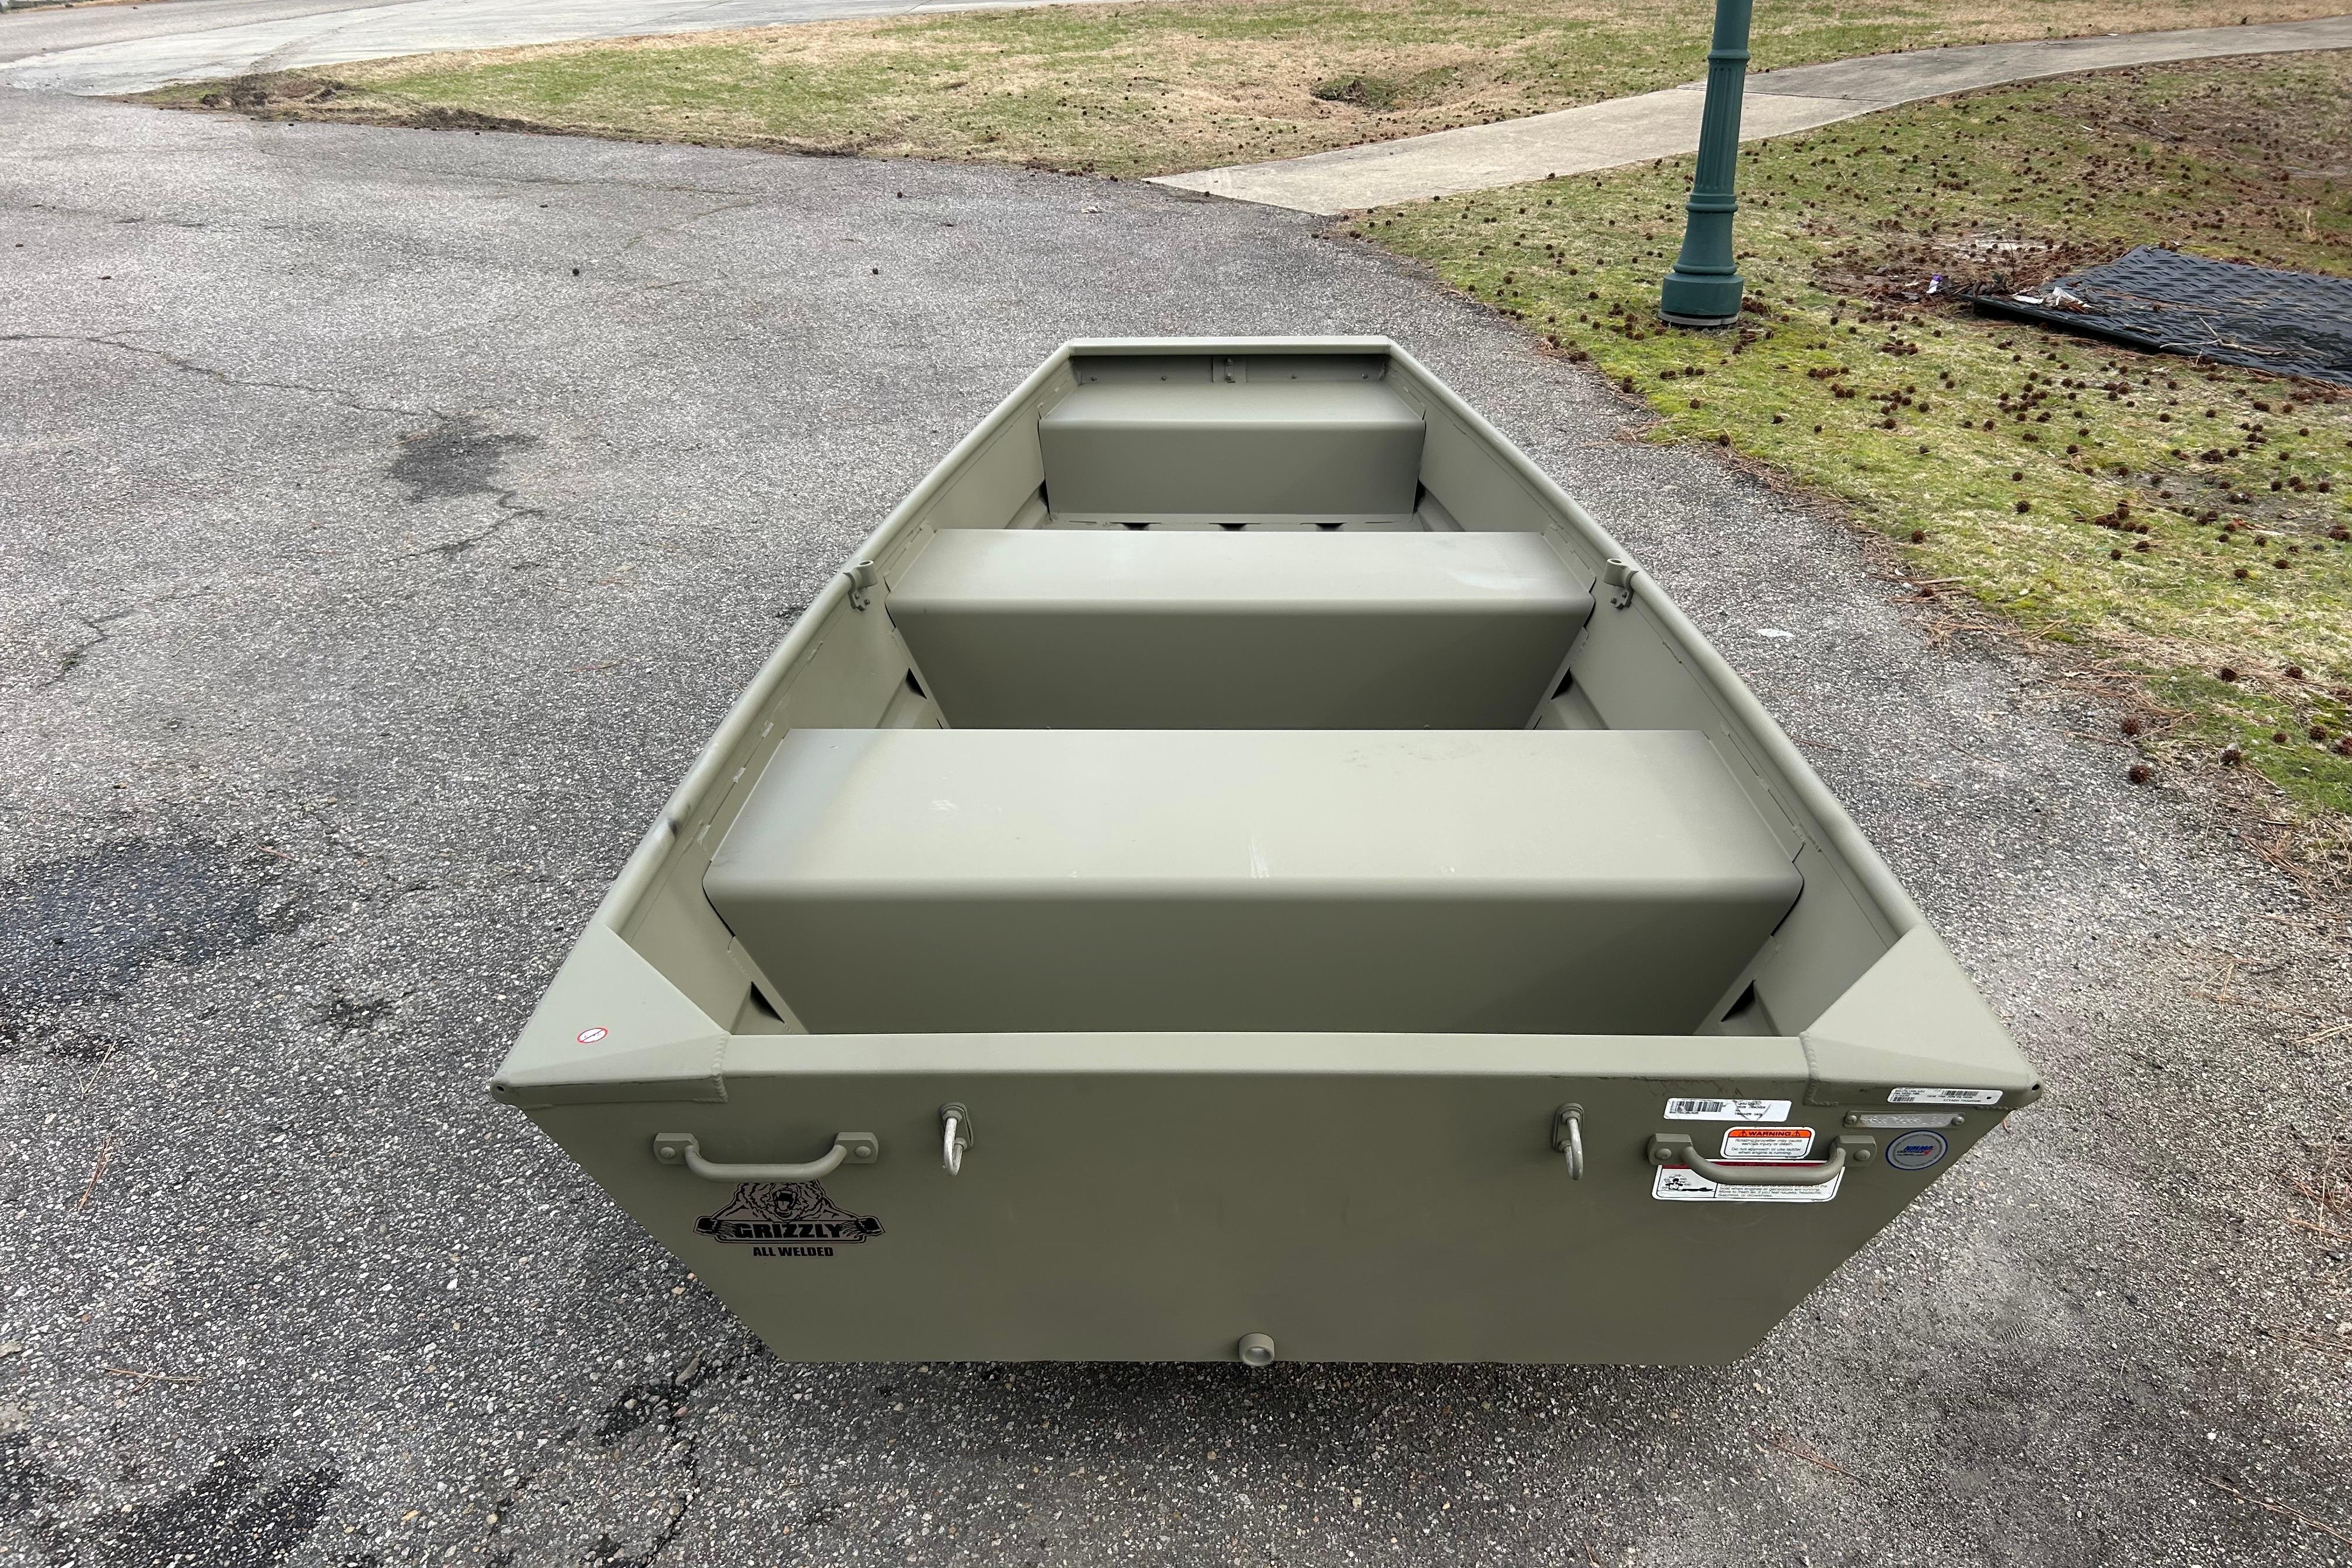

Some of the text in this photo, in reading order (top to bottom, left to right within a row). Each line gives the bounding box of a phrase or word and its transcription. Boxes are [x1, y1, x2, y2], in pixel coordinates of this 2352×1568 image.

[734, 1223, 842, 1238] GRIZZLY
[753, 1247, 834, 1256] ALL WELDED
